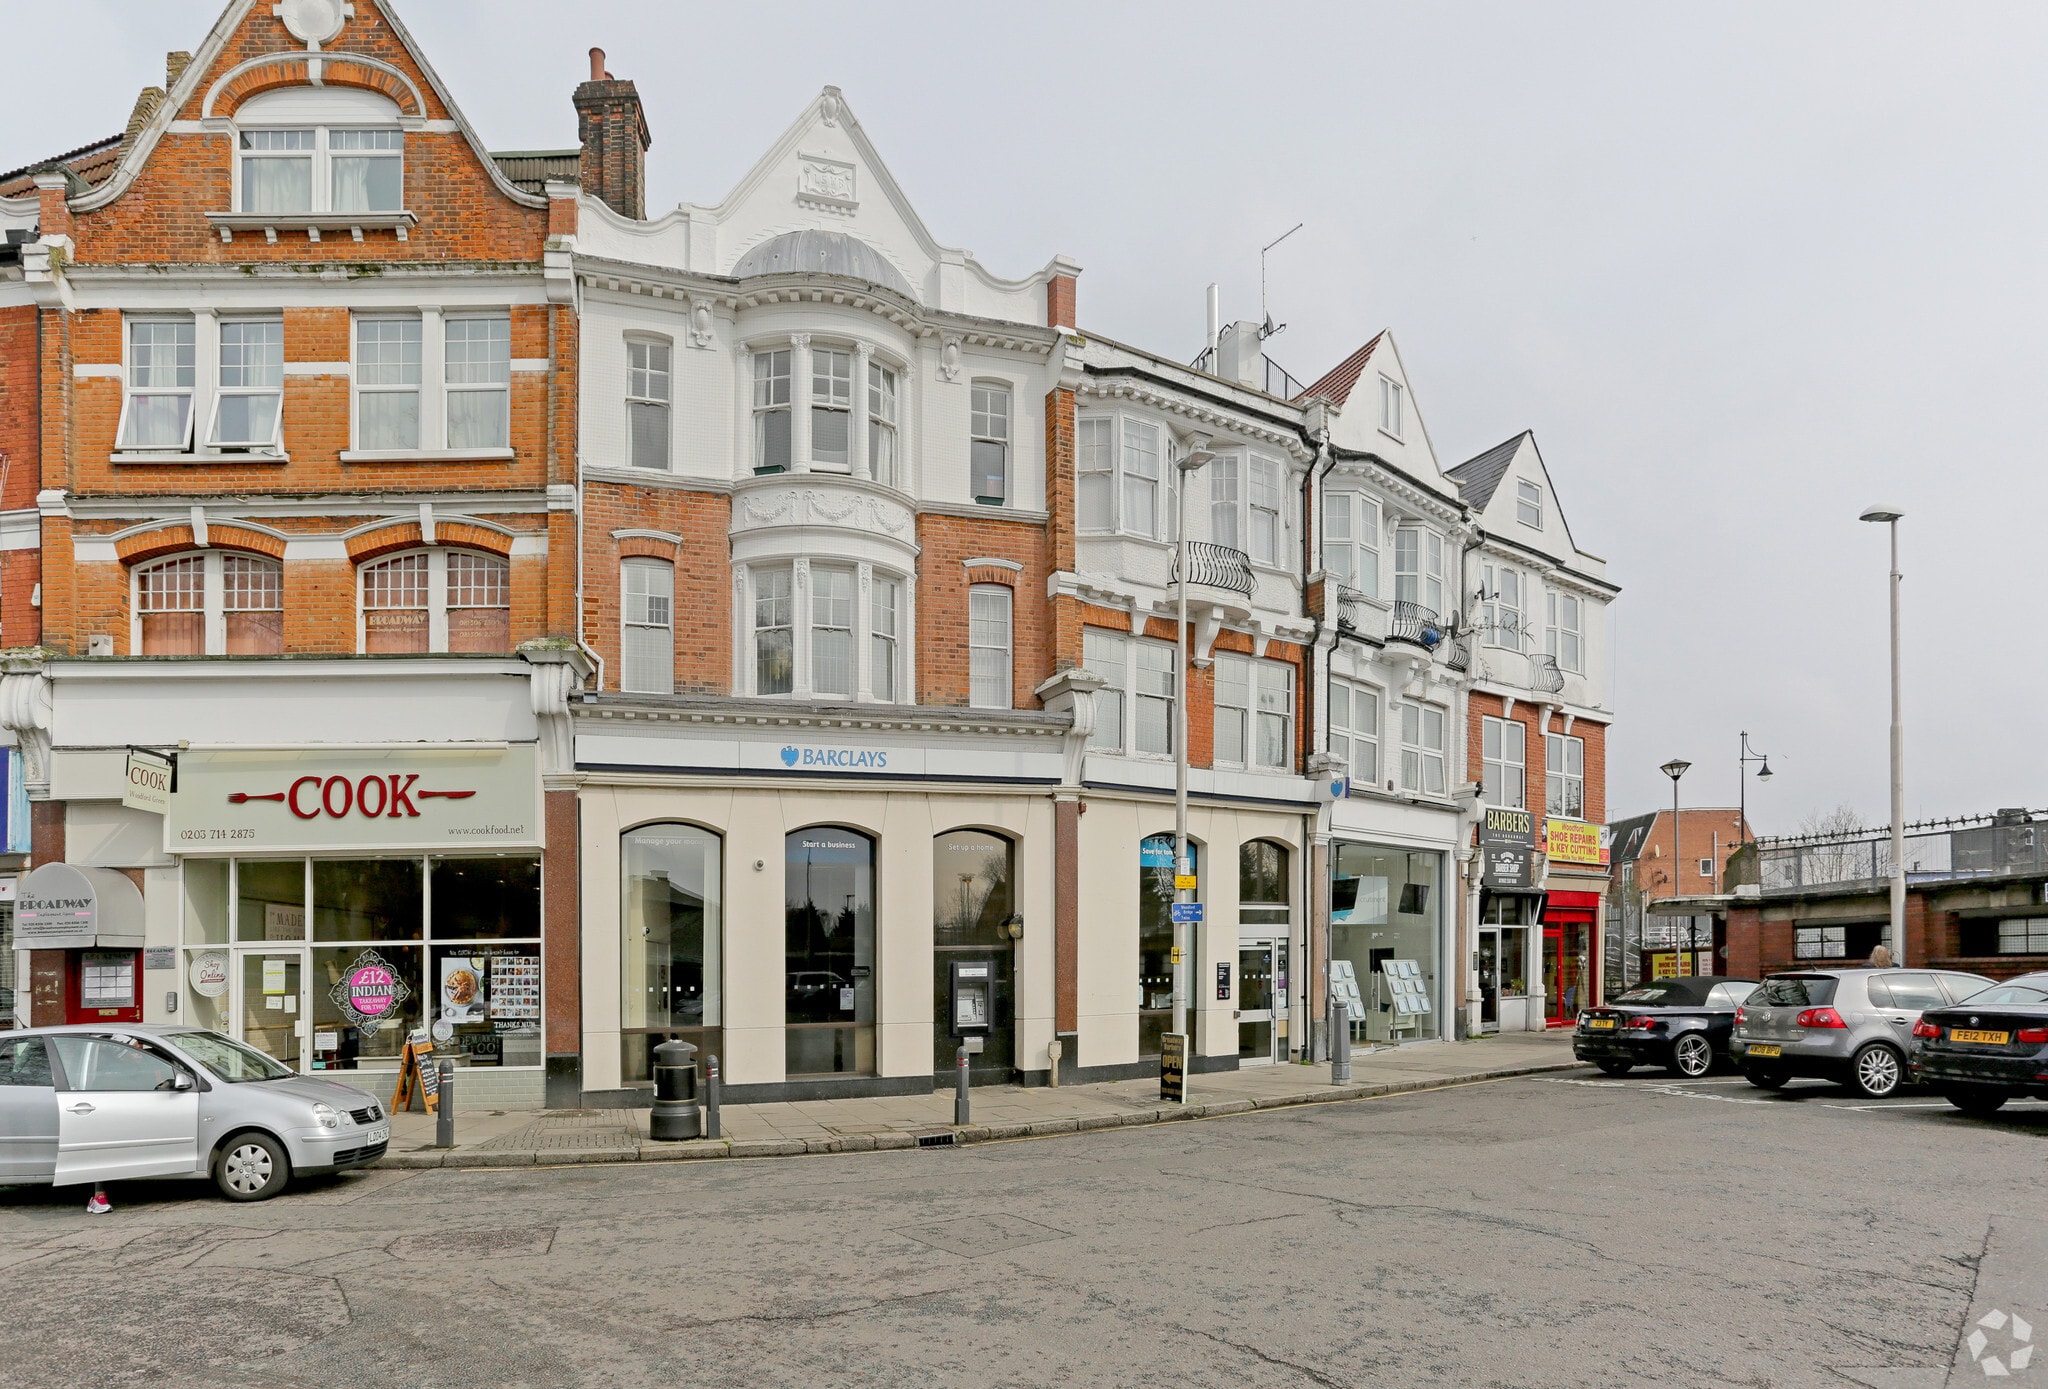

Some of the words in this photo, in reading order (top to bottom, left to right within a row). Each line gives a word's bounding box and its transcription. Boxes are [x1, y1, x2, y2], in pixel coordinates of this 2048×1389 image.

[369, 615, 426, 626] BROADWAY
[803, 749, 887, 768] BARCLAYS
[130, 767, 167, 791] COOK
[289, 774, 421, 819] COOK
[1487, 810, 1530, 833] BARBERS
[448, 824, 525, 835] www.cookfood.net
[1562, 823, 1584, 832] Woodford
[181, 830, 206, 839] 0203
[210, 830, 226, 839] 714
[230, 829, 255, 839] 2875
[1550, 831, 1568, 842] SHOE
[1570, 833, 1597, 845] REPAIRS
[634, 837, 663, 846] Manage
[802, 841, 819, 849] Start
[828, 841, 855, 849] business
[1550, 842, 1555, 852] &
[1557, 843, 1569, 853] KEY
[1570, 845, 1597, 856] CUTTING
[1495, 863, 1509, 872] BARBER
[1509, 863, 1520, 873] SHOP
[19, 899, 92, 910] BROADWAY
[276, 912, 303, 927] MADE
[204, 960, 220, 970] Shop
[200, 970, 226, 979] Online
[359, 970, 386, 985] £12
[352, 985, 392, 997] INDIAN
[1957, 1031, 1979, 1040] FE12
[1980, 1032, 2002, 1041] TXH
[1162, 1055, 1182, 1069] OPEN
